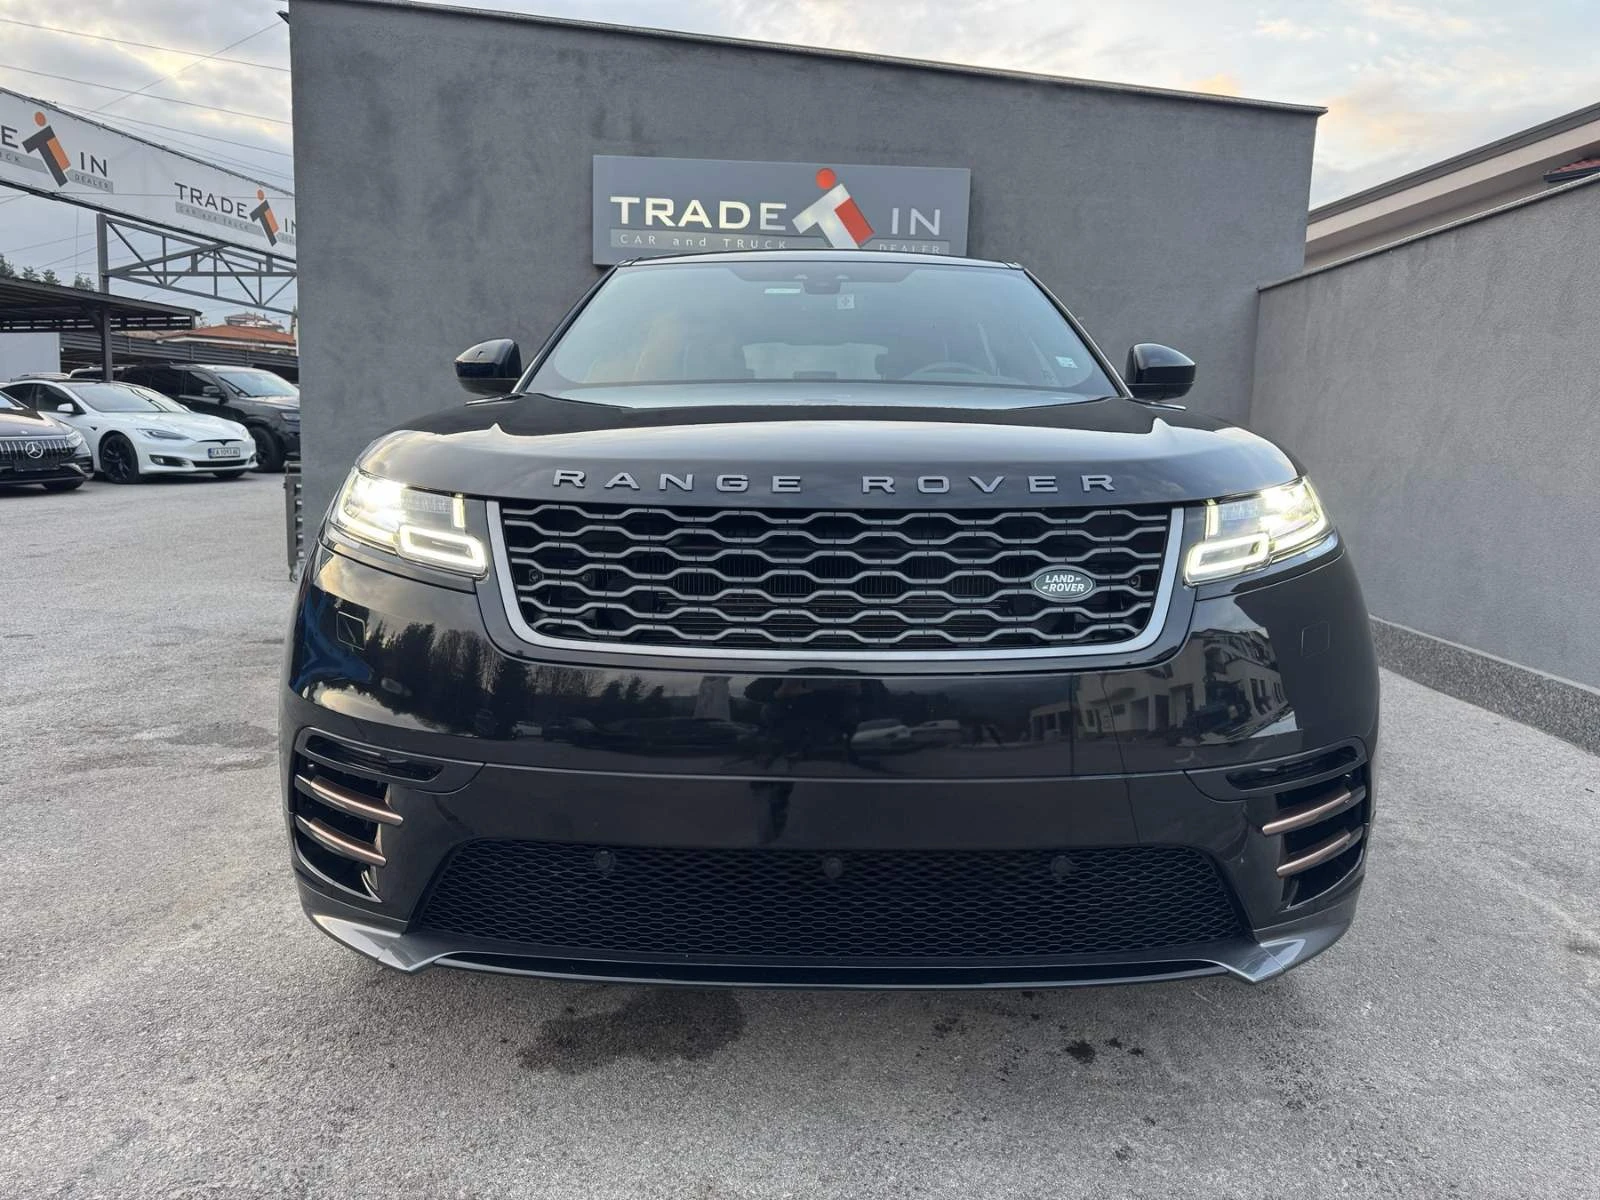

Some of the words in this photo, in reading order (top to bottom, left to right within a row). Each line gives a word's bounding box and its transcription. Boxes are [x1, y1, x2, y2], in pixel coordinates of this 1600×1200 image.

[80, 151, 107, 178] IN
[174, 182, 248, 220] TRADE
[610, 196, 787, 231] TRADE
[892, 207, 941, 236] IN
[620, 233, 656, 245] CAR
[673, 237, 707, 247] and
[723, 238, 786, 249] TRUCK
[552, 469, 802, 494] RANGE
[861, 474, 1116, 494] ROVER
